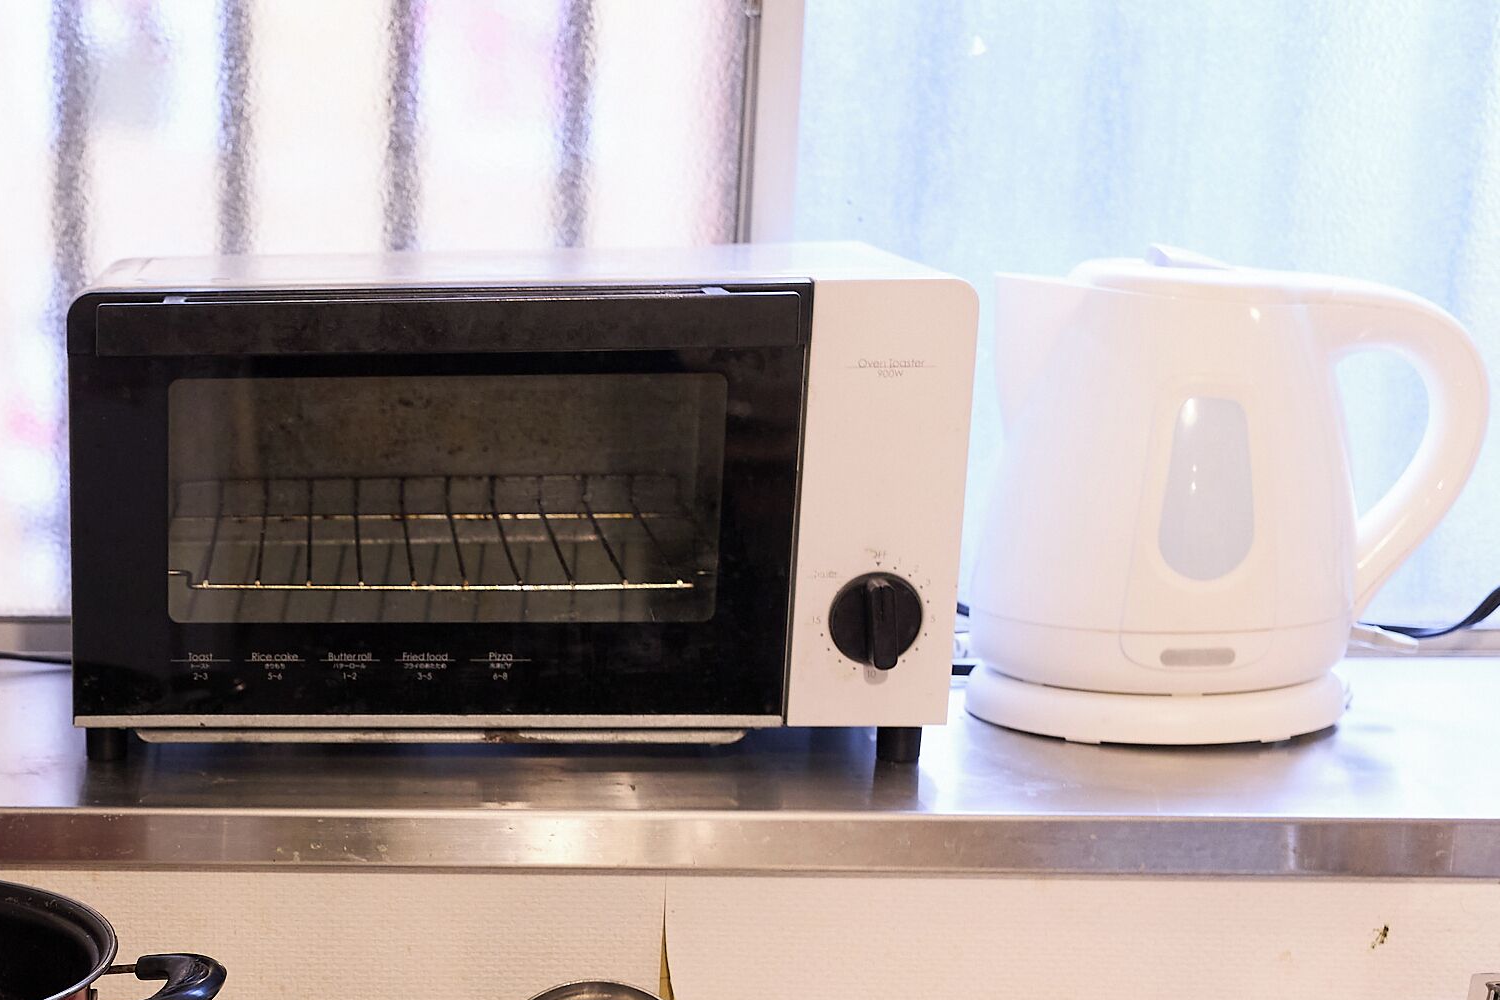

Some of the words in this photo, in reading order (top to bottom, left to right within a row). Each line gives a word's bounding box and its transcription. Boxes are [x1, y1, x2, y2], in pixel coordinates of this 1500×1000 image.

[888, 358, 924, 369] Toaster
[188, 652, 213, 662] Toast
[251, 652, 277, 662] Rice
[278, 652, 299, 662] cake
[328, 652, 356, 662] Butter
[357, 652, 373, 662] roll
[402, 652, 425, 662] Fried
[426, 652, 449, 662] food
[488, 652, 513, 662] Pizza
